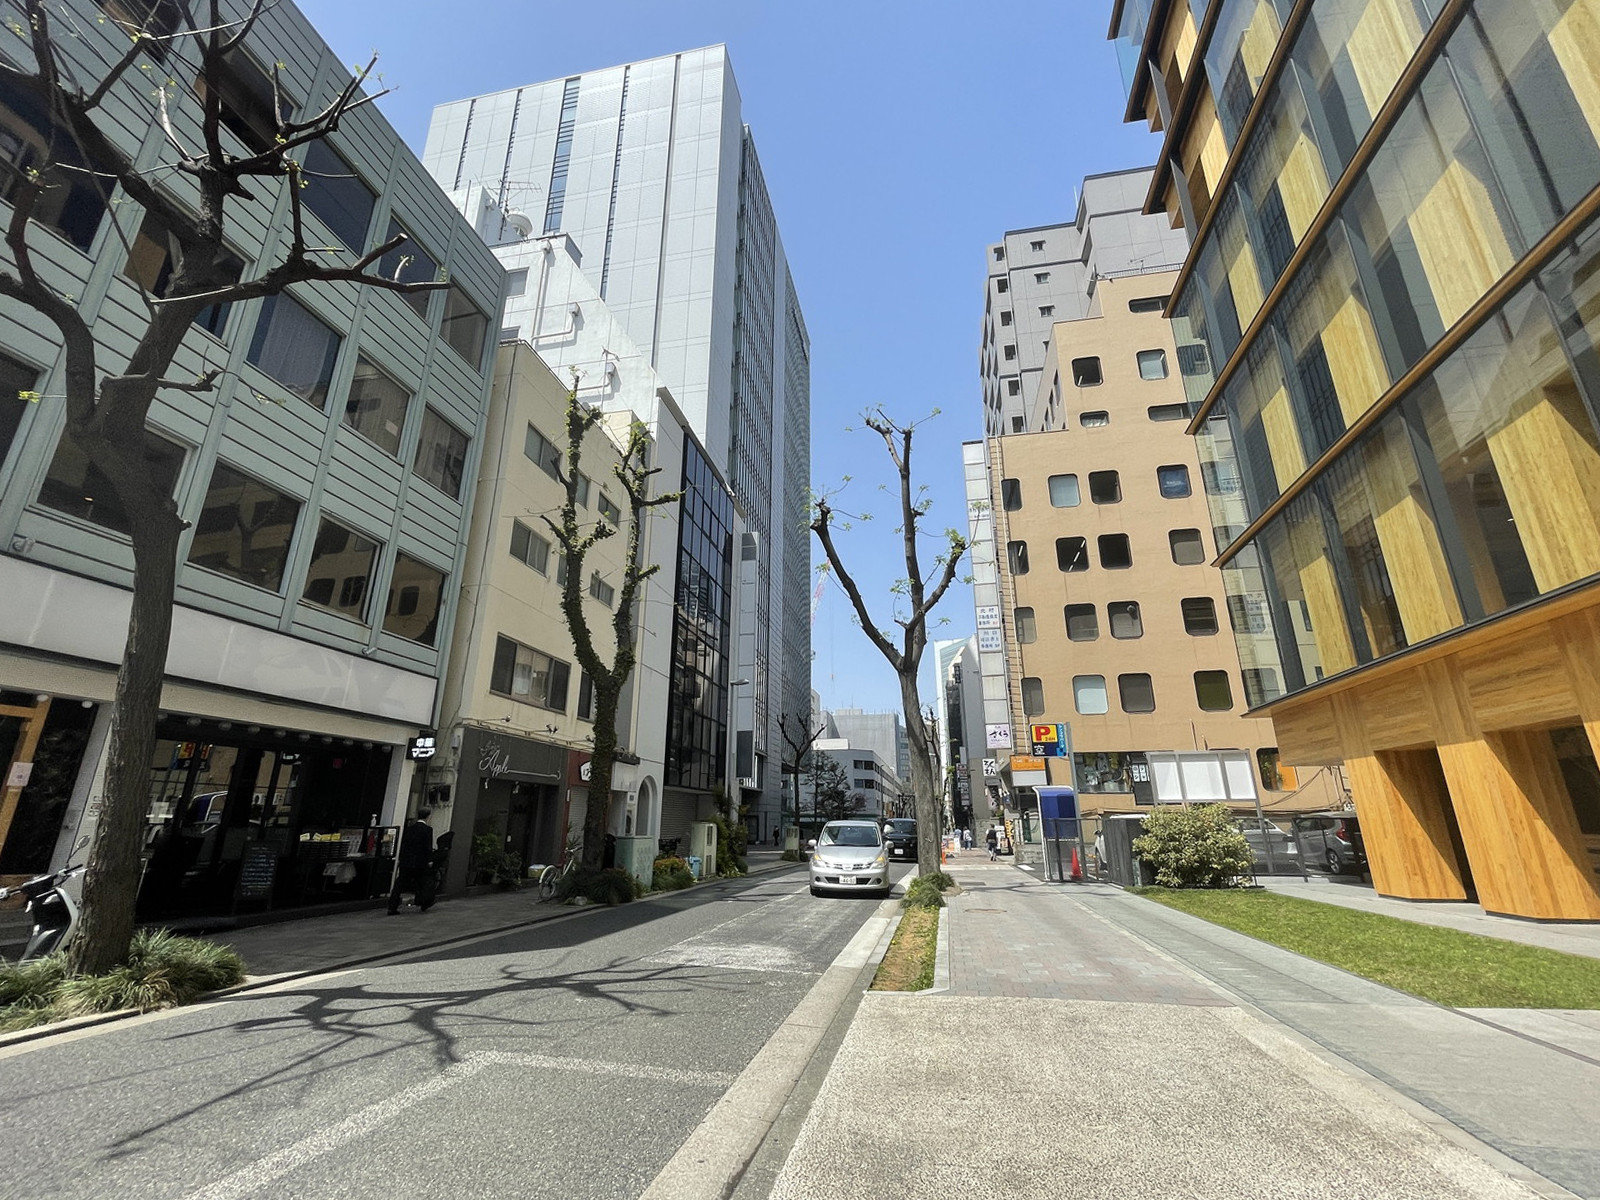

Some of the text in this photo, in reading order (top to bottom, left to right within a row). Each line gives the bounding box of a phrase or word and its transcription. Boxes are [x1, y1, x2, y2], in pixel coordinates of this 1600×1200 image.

[1034, 726, 1051, 741] P
[411, 748, 436, 757] マニア
